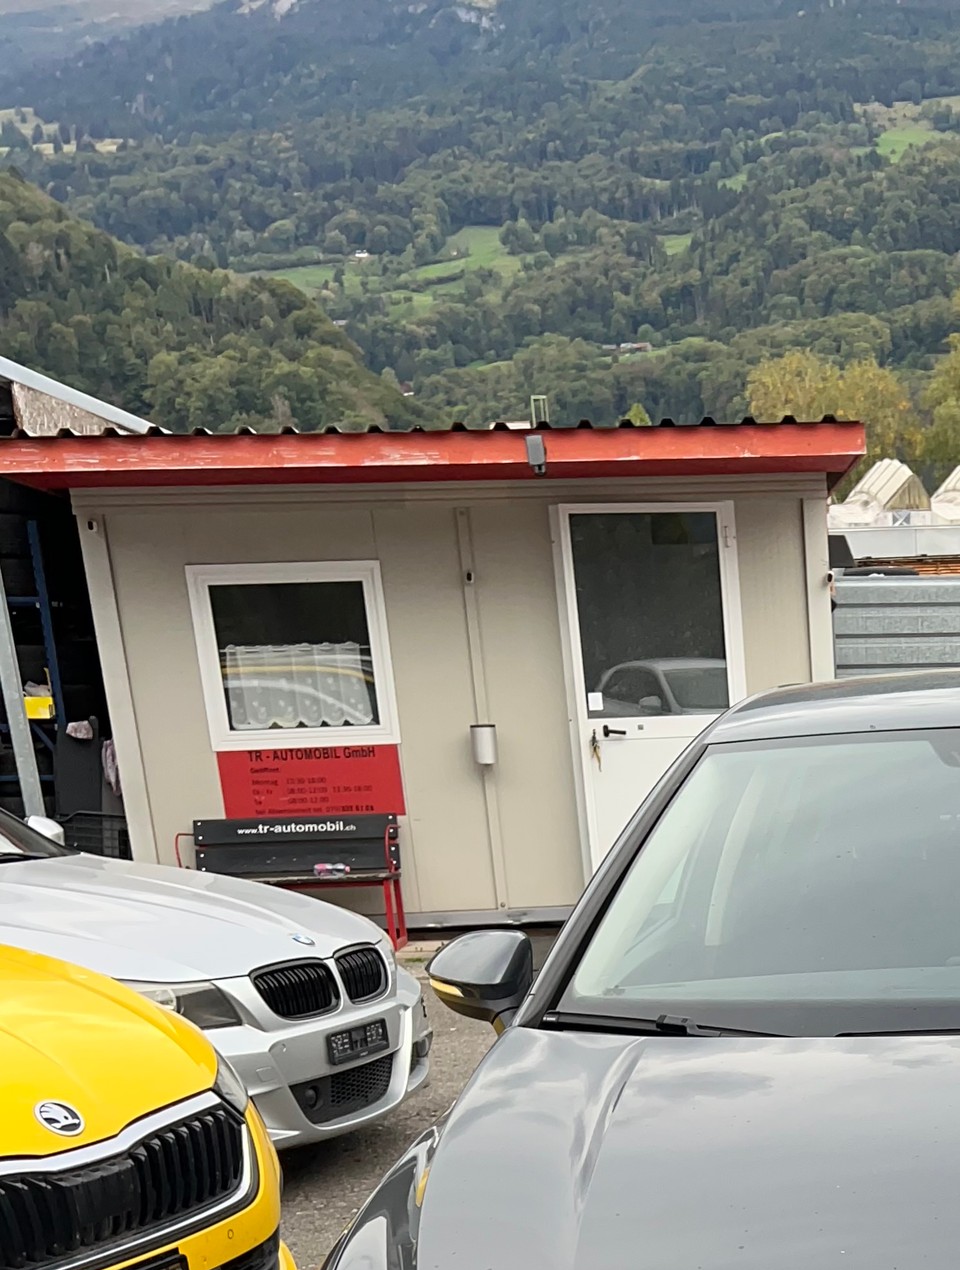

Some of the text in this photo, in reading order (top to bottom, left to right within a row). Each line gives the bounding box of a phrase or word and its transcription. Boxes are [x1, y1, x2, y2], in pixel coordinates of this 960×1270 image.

[248, 751, 263, 762] TR
[272, 748, 341, 761] AUTOMOBIL
[344, 746, 376, 758] GmbH
[236, 821, 356, 834] www.tr-automobil.ch
